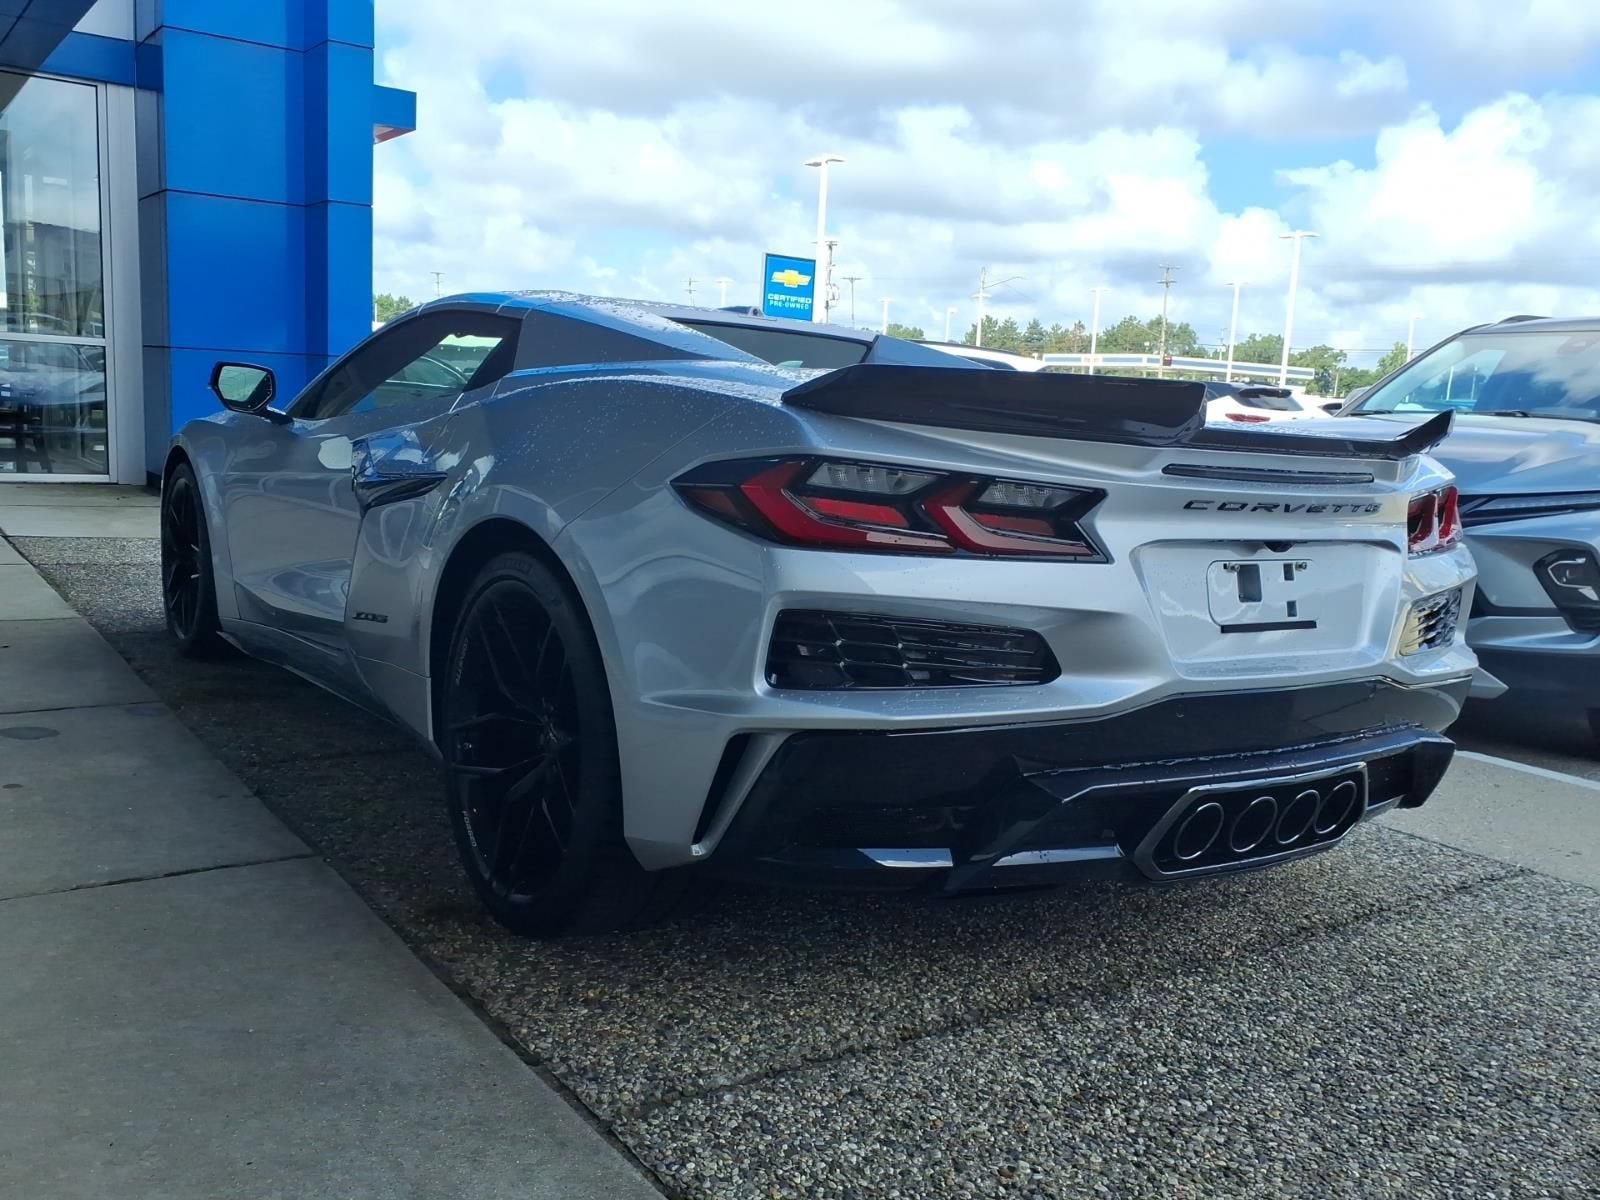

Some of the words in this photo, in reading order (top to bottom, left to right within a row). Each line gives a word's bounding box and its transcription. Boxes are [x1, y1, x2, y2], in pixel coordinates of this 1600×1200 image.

[767, 293, 812, 304] CERTIFIED
[769, 300, 809, 310] PRE-OWNED
[1183, 499, 1383, 513] CORVETTE
